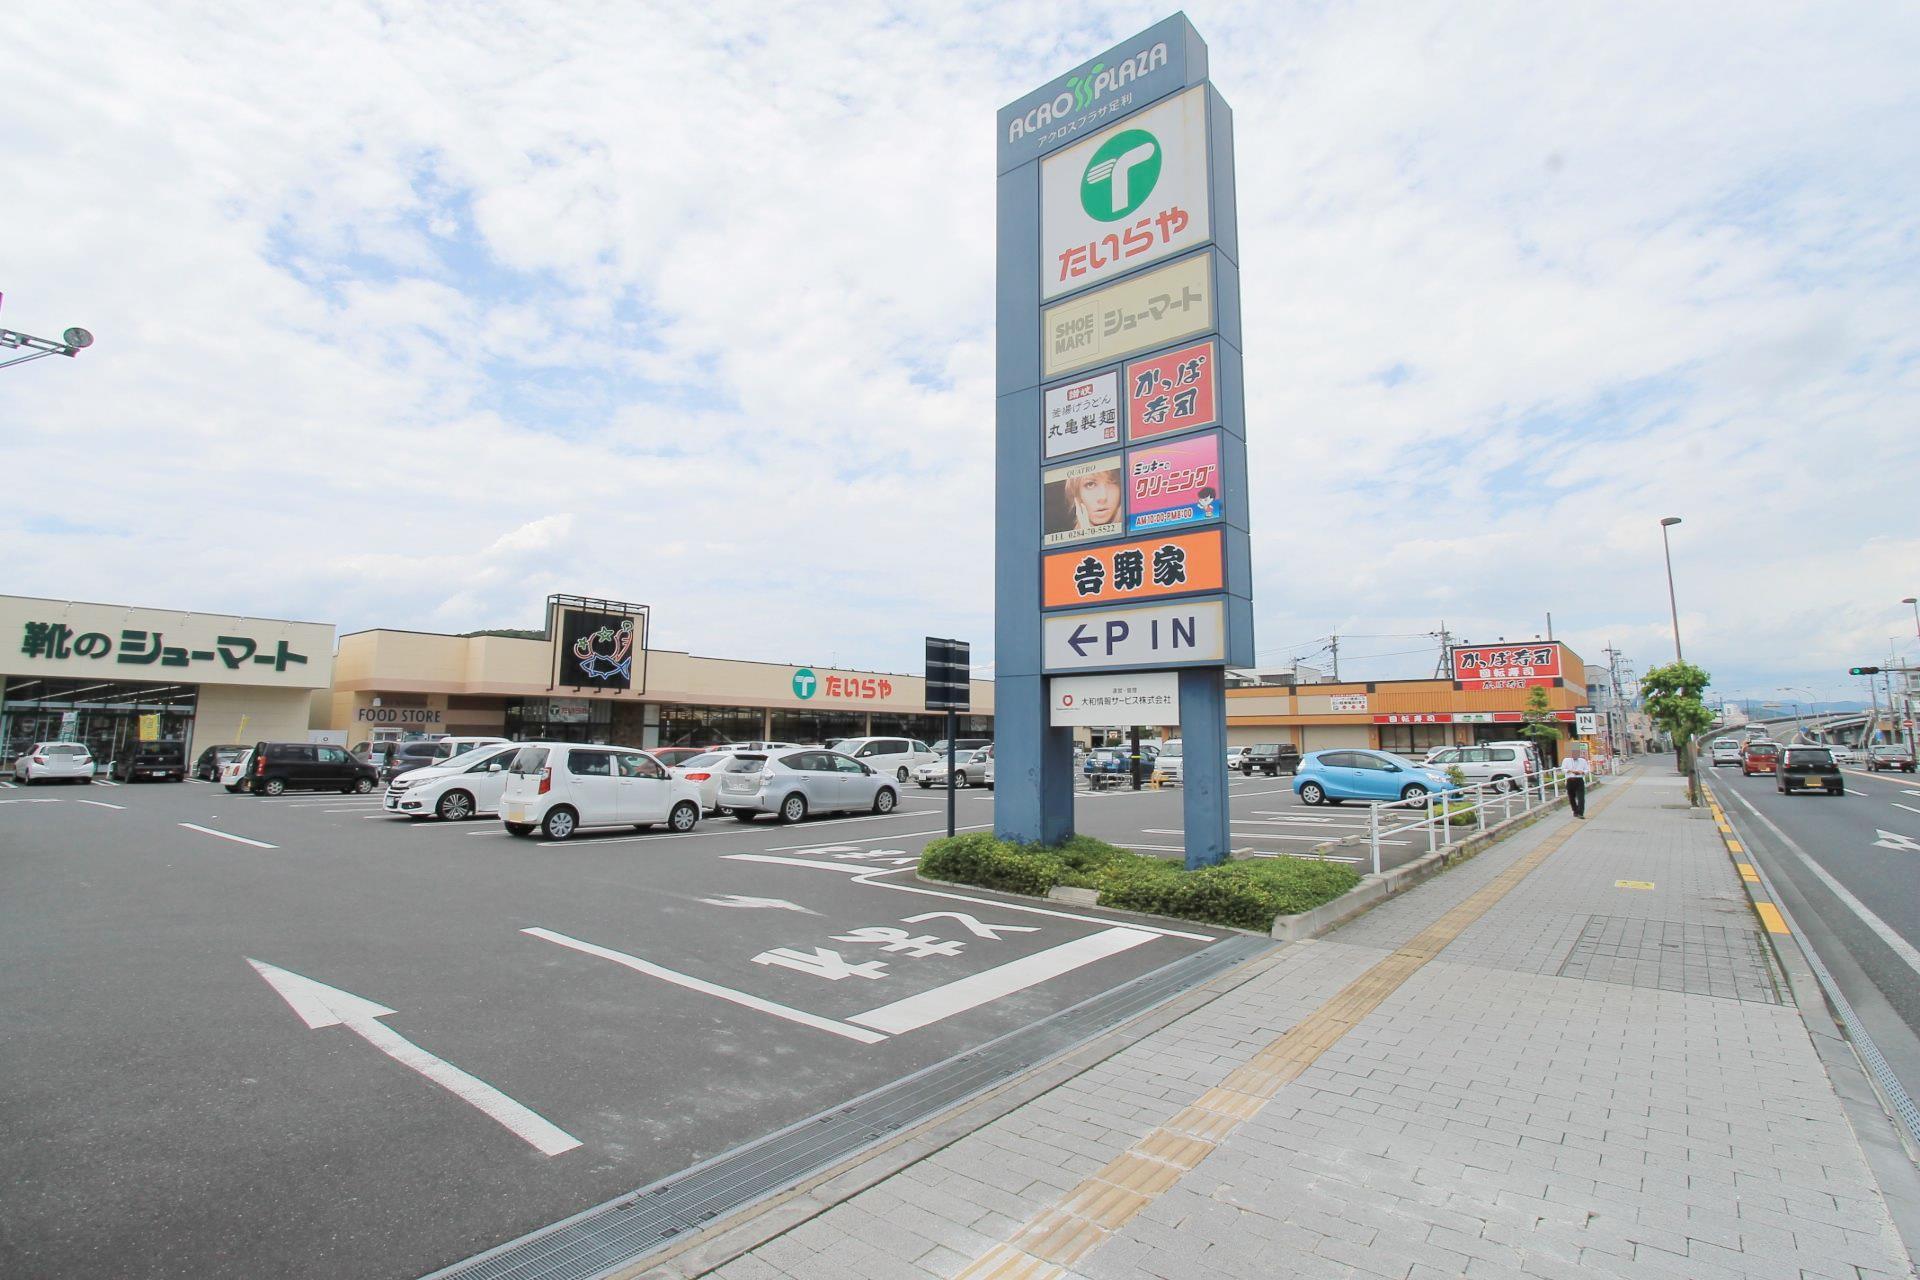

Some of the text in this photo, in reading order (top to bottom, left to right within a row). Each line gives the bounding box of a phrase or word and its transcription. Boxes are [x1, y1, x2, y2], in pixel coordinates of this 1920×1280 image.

[1094, 42, 1168, 100] PLAZA
[1037, 92, 1132, 148] アクロスプラザ足利
[1058, 206, 1188, 282] たいらや
[1055, 313, 1094, 339] SHOE
[1103, 286, 1203, 338] シューマート
[1055, 331, 1094, 354] MART
[1134, 355, 1206, 399] かっぱ
[1143, 387, 1198, 424] 寿司
[1048, 408, 1115, 439] 丸亀製麺
[1134, 460, 1170, 476] ミッキーの
[1136, 464, 1216, 499] クリーニング
[21, 621, 308, 671] 靴のシューマート
[1106, 616, 1195, 655] P IN
[1461, 648, 1552, 669] かっぱ寿司
[825, 675, 893, 699] たいらや
[358, 708, 441, 723] FOOD STORE
[1579, 716, 1592, 724] IN
